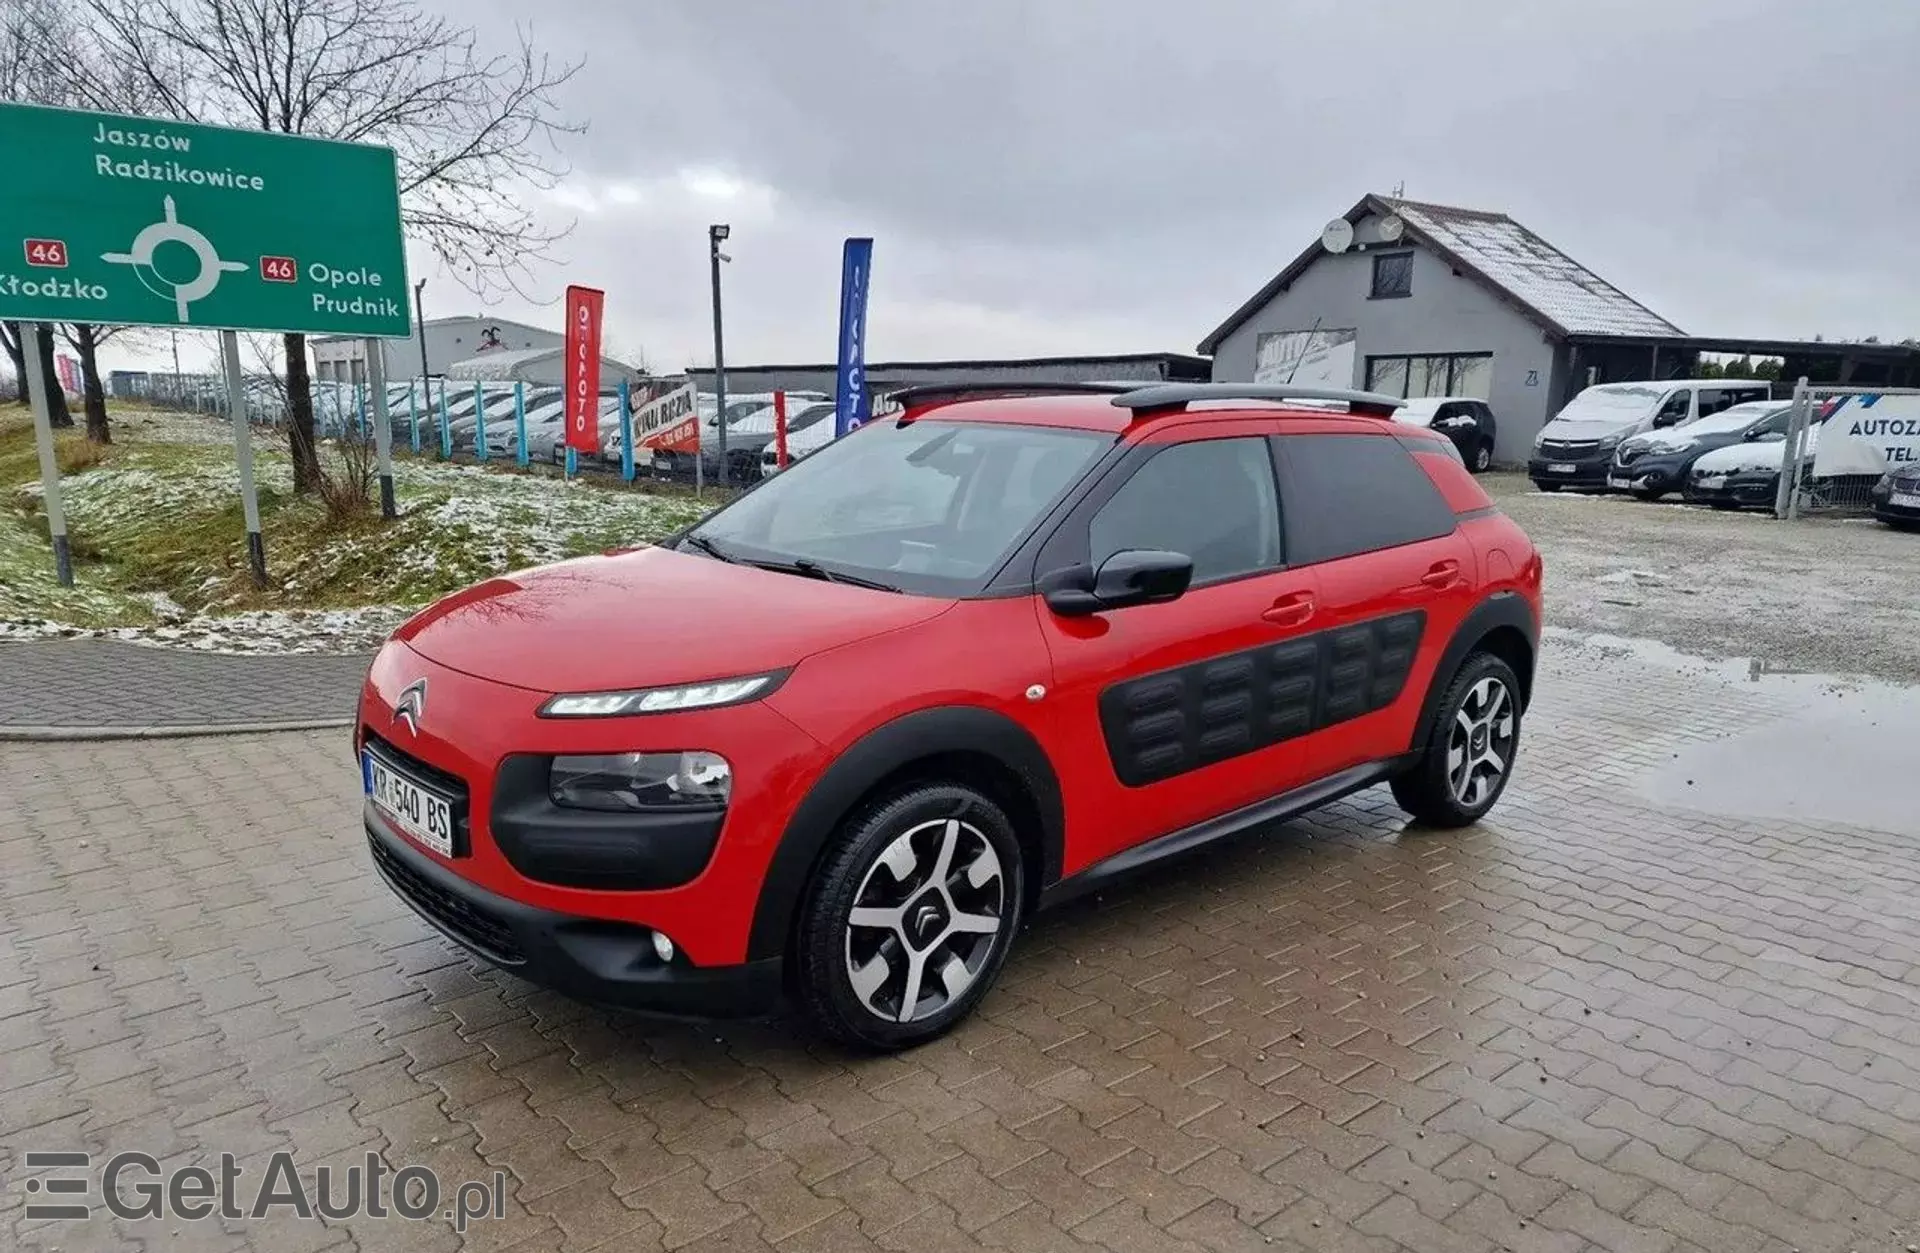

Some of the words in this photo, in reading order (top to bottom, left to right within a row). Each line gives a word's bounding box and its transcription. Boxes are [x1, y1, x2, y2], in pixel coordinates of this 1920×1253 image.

[93, 122, 191, 152] Jaszów
[96, 154, 265, 191] Radzikowice
[32, 244, 61, 262] 46
[267, 261, 292, 279] 46
[308, 263, 383, 287] Opole
[312, 294, 400, 317] Prudnik
[1885, 446, 1918, 462] TEL.
[395, 779, 419, 824] 540
[427, 797, 447, 839] BS
